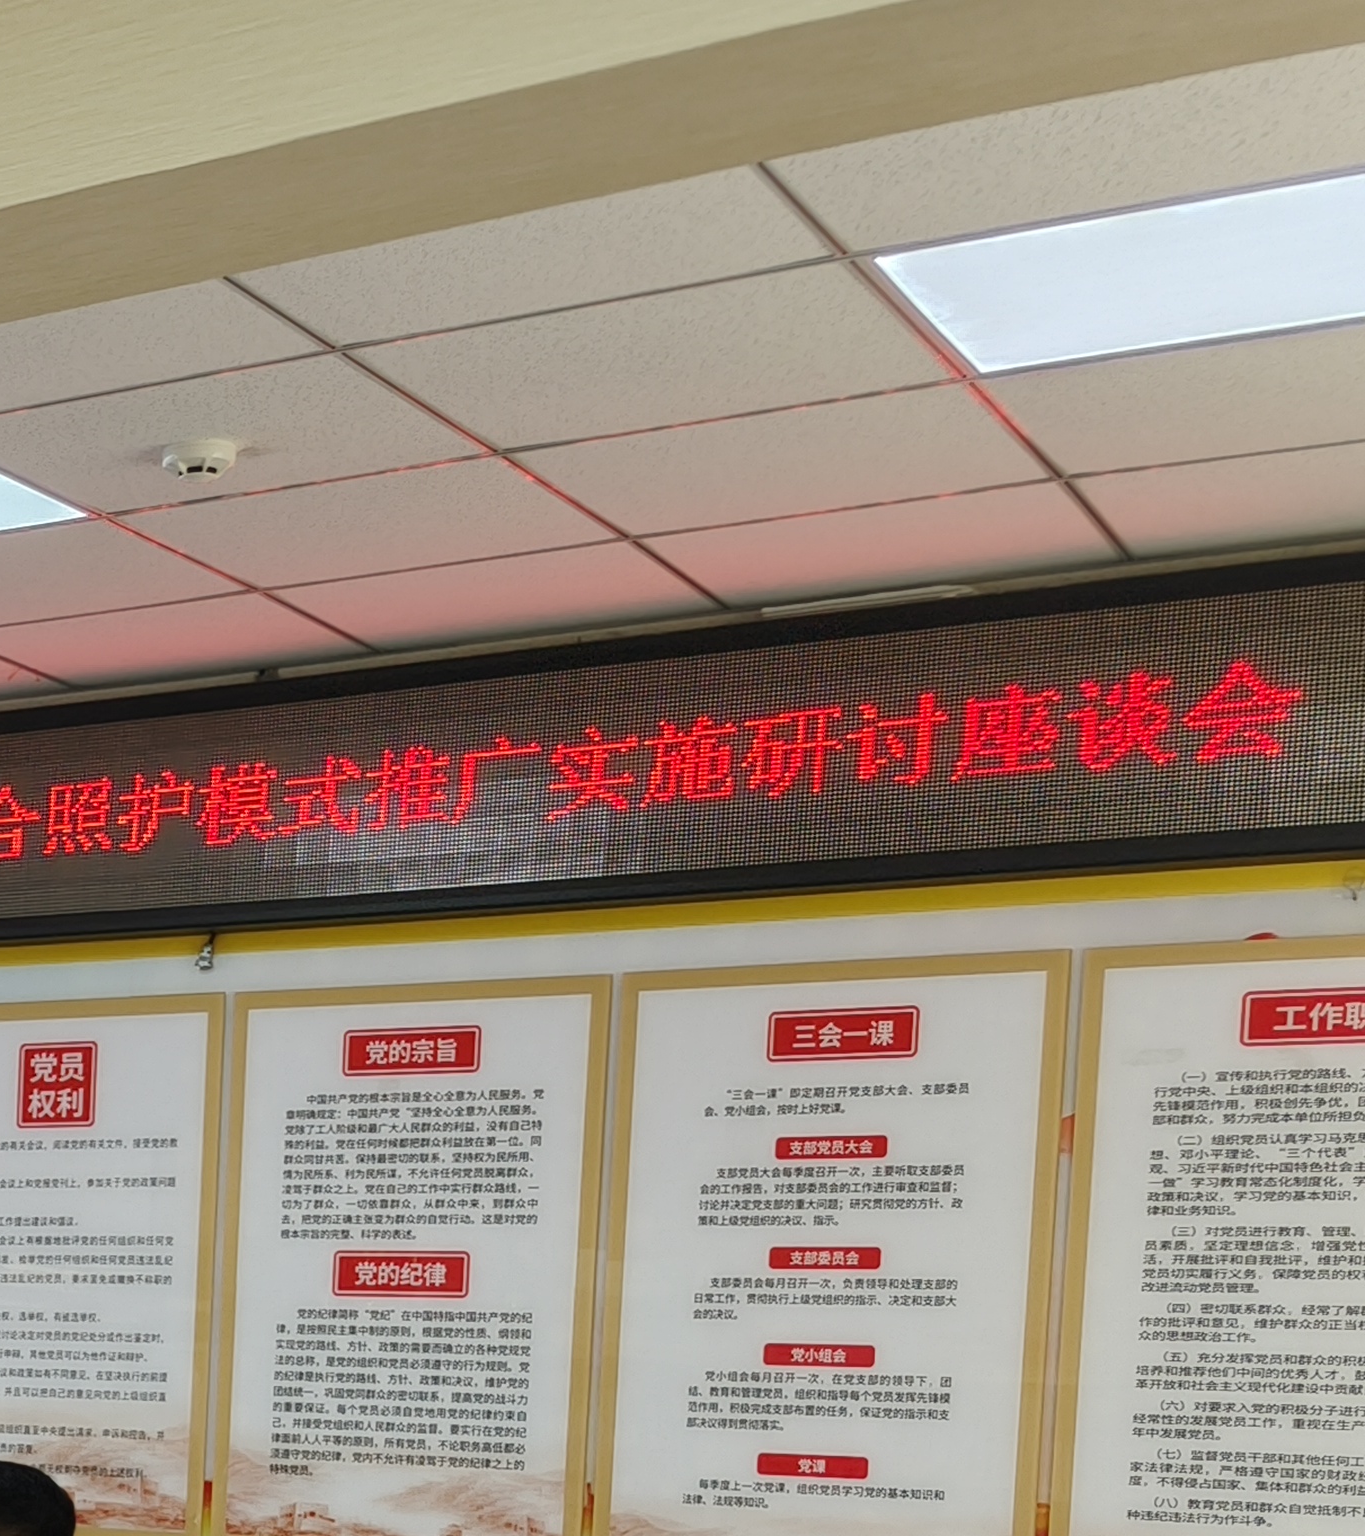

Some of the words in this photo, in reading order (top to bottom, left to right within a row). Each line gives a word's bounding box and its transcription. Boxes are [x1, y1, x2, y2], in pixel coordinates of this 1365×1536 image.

[791, 1019, 895, 1051] 三会一课
[365, 1038, 458, 1066] 党的宗旨
[29, 1051, 85, 1084] 党员
[1181, 1068, 1365, 1083] （一）宣传和执行党的路线、
[27, 1088, 84, 1119] 权利
[789, 1140, 873, 1155] 支部党员大会
[789, 1251, 859, 1266] 支部委员会
[1143, 1254, 1365, 1266] 活，开展批评和自我批评，维护和
[354, 1261, 448, 1288] 党的纪律
[1141, 1268, 1365, 1281] 党员切实履行义务，保障党员的权
[790, 1348, 846, 1363] 党小组会
[797, 1458, 826, 1474] 党课
[1154, 1496, 1365, 1518] （八）教育党员和群众自觉抵制不
